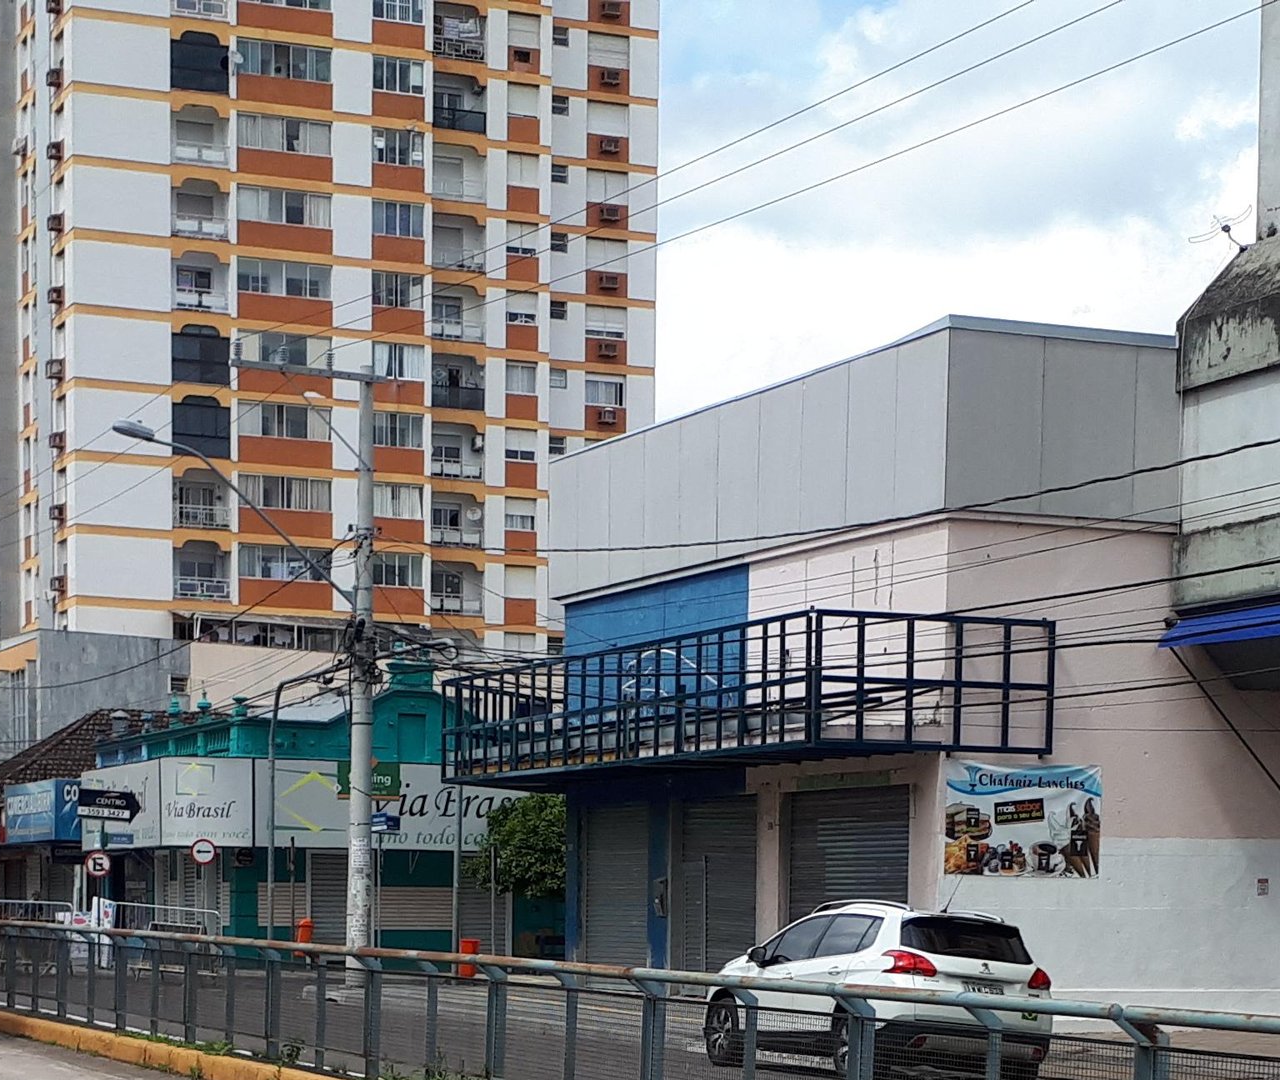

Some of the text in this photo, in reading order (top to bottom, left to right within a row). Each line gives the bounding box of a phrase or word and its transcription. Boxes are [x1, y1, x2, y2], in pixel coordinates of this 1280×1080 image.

[95, 797, 127, 807] CENTRO
[996, 802, 1016, 813] mais
[415, 824, 456, 845] todo
